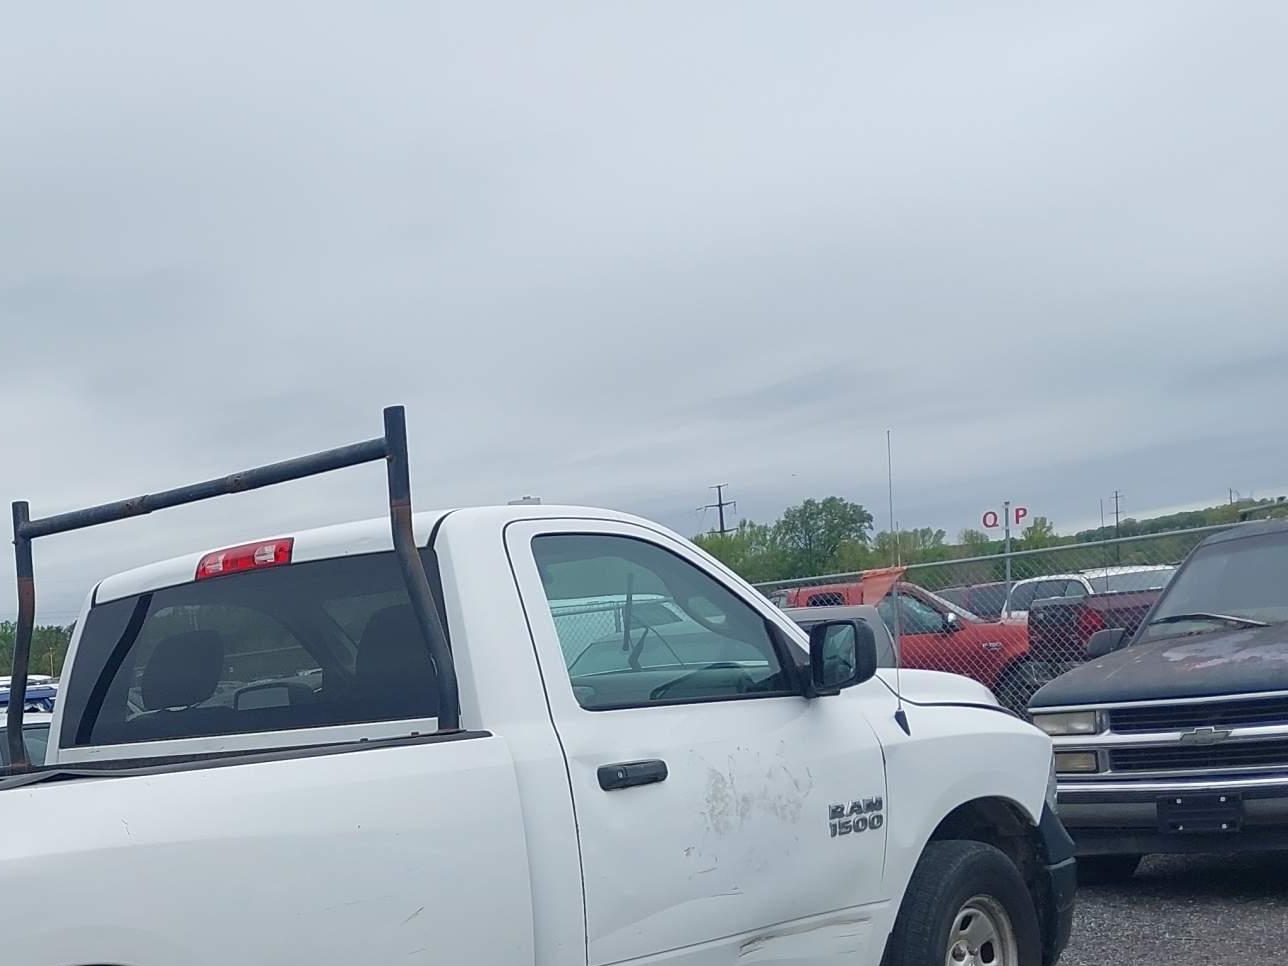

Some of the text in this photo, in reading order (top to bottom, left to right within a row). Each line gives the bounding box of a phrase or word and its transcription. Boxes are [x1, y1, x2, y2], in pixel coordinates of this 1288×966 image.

[982, 507, 1027, 528] Q P
[828, 796, 883, 820] RAM
[829, 814, 884, 838] 1500
